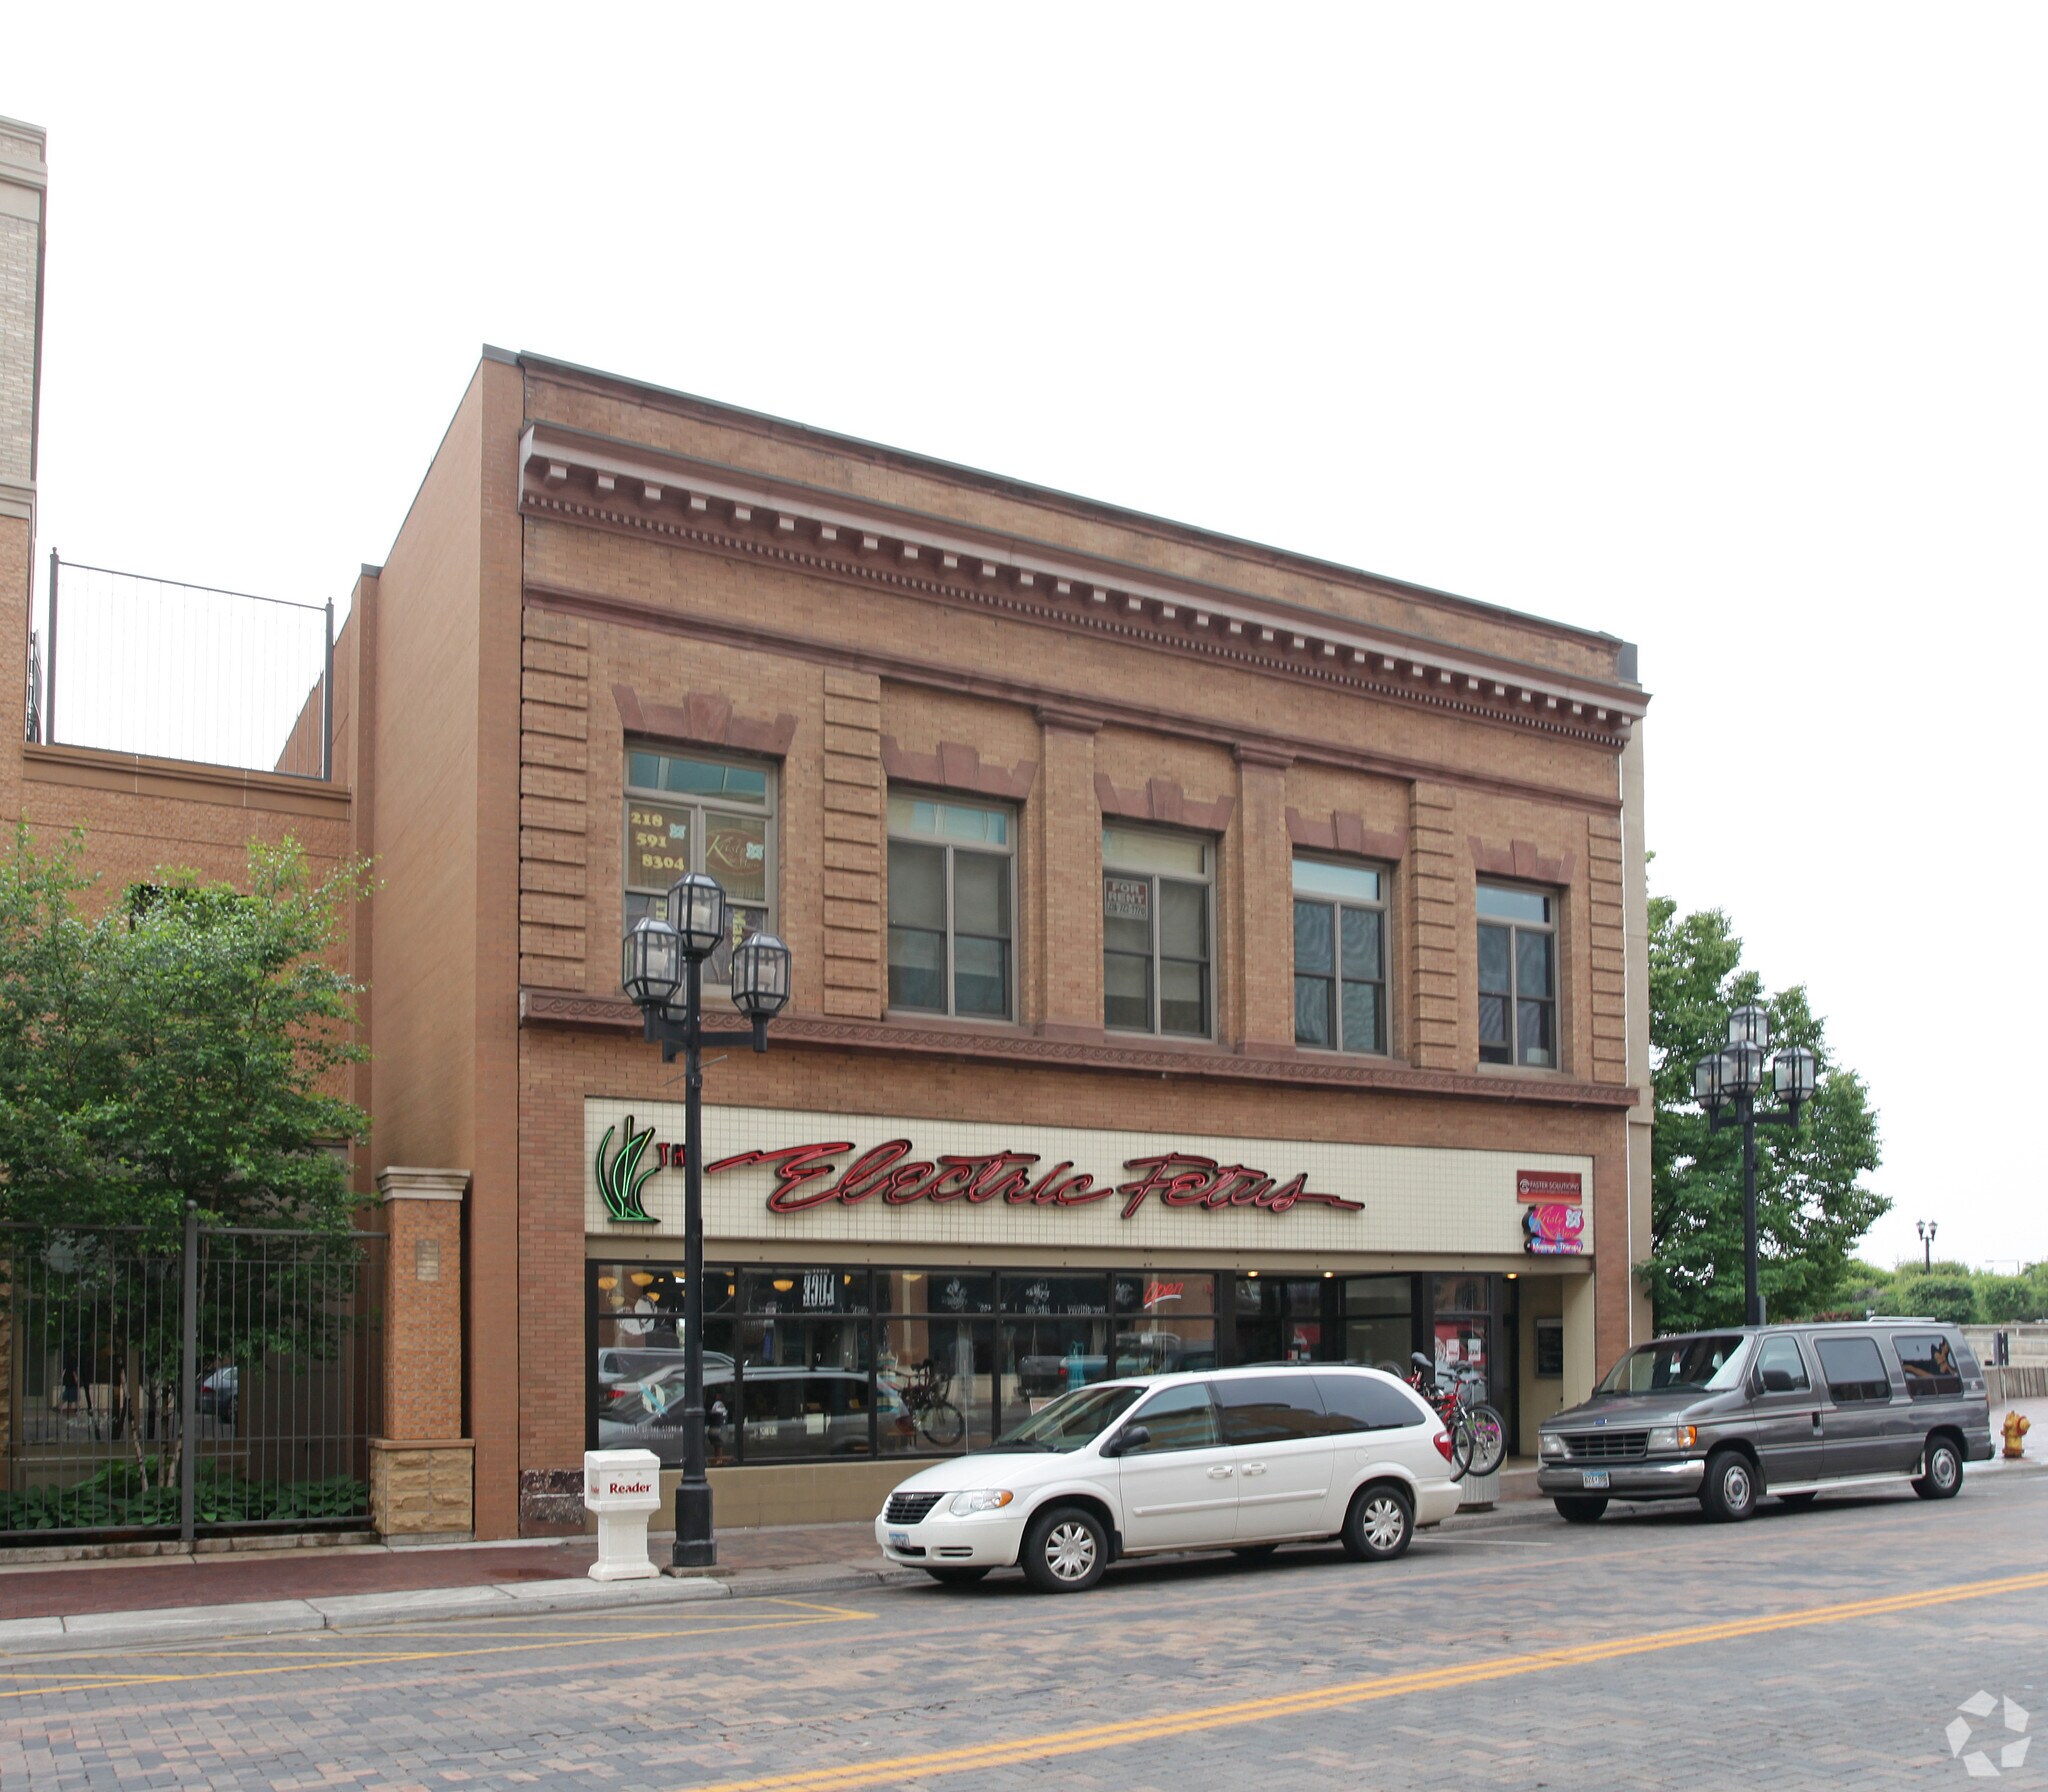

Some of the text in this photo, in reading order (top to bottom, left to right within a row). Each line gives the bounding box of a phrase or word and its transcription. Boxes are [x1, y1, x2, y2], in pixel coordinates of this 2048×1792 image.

[630, 811, 663, 828] 218
[635, 832, 667, 849] 591
[641, 854, 685, 871] 8304
[1112, 882, 1139, 893] FOR
[1108, 892, 1145, 904] RENT
[655, 1139, 1366, 1220] TH Electric Fetus
[1530, 1180, 1580, 1191] FASTER SOLUTIONS
[1144, 1281, 1185, 1304] Open
[609, 1482, 652, 1494] Reader
